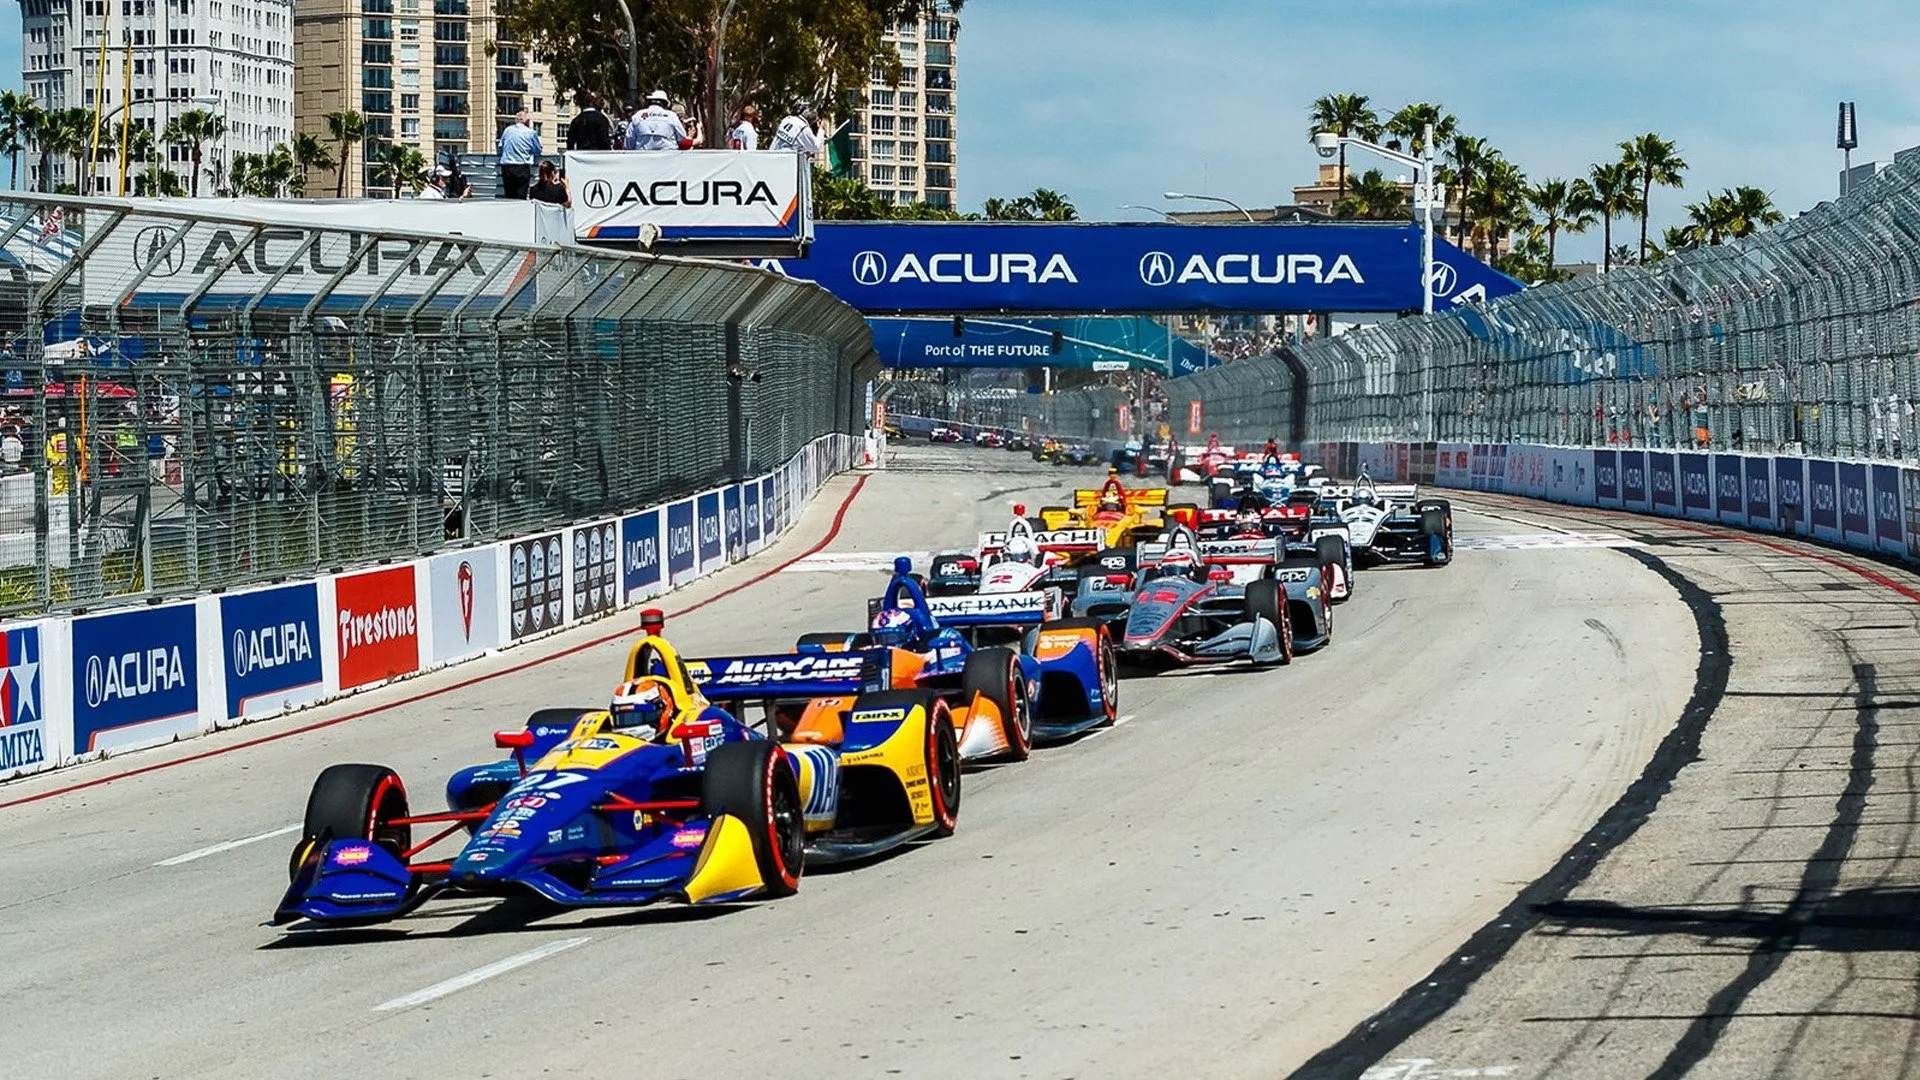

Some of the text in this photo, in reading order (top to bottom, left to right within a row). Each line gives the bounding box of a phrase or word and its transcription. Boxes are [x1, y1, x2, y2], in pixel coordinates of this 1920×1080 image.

[615, 181, 778, 206] ACURA
[191, 230, 487, 276] ACURA
[889, 253, 1079, 283] ACURA
[1176, 254, 1365, 284] ACURA
[925, 344, 1050, 357] Port of THE FUTURE
[1205, 509, 1308, 518] TOAL
[675, 526, 692, 553] ACURA
[990, 530, 1098, 545] HACHI
[632, 537, 657, 569] ACURA
[978, 597, 1043, 611] BANK
[248, 620, 313, 671] ACURA
[340, 605, 415, 660] Firestone
[103, 645, 186, 702] ACURA
[0, 728, 44, 770] MIYA
[504, 771, 590, 798] 27
